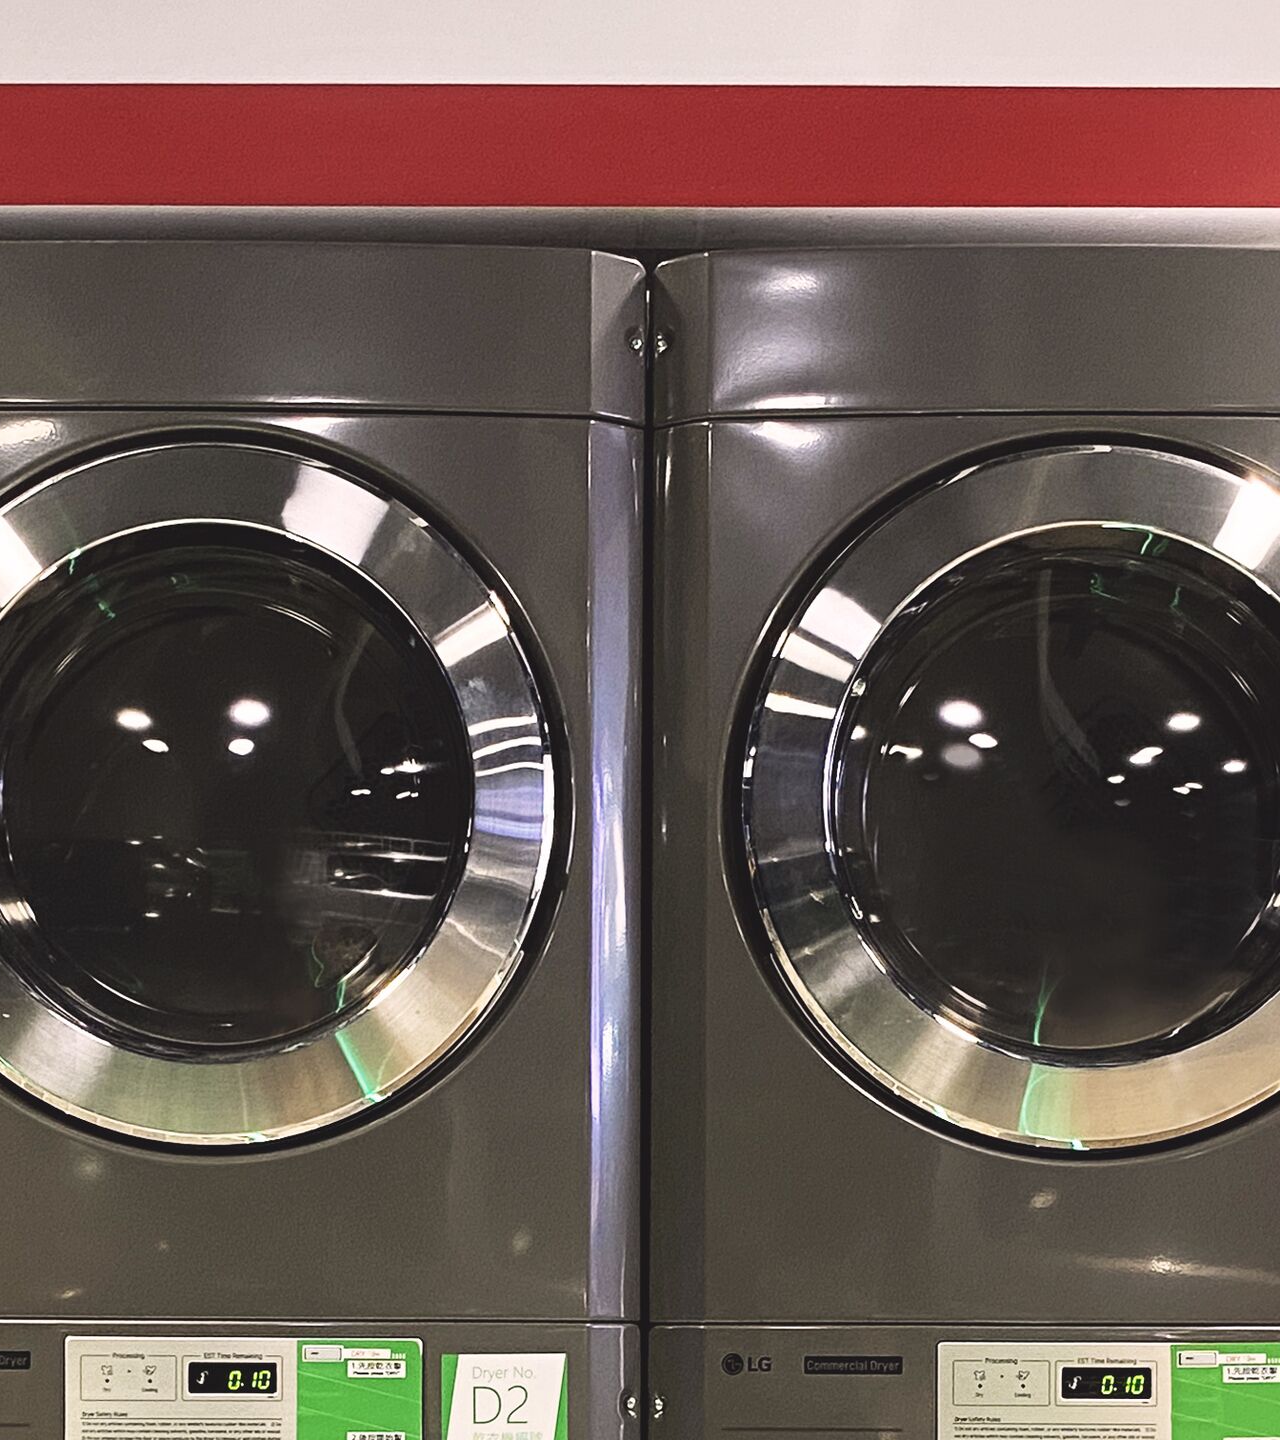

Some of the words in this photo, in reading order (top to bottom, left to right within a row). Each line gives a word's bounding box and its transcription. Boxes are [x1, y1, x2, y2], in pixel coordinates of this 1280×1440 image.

[0, 1356, 28, 1366] Dryer
[748, 1357, 771, 1372] LG
[807, 1360, 867, 1371] Commercial
[870, 1361, 900, 1372] Dryer
[473, 1366, 509, 1381] Dryer
[513, 1367, 536, 1379] No.
[473, 1385, 528, 1424] D2
